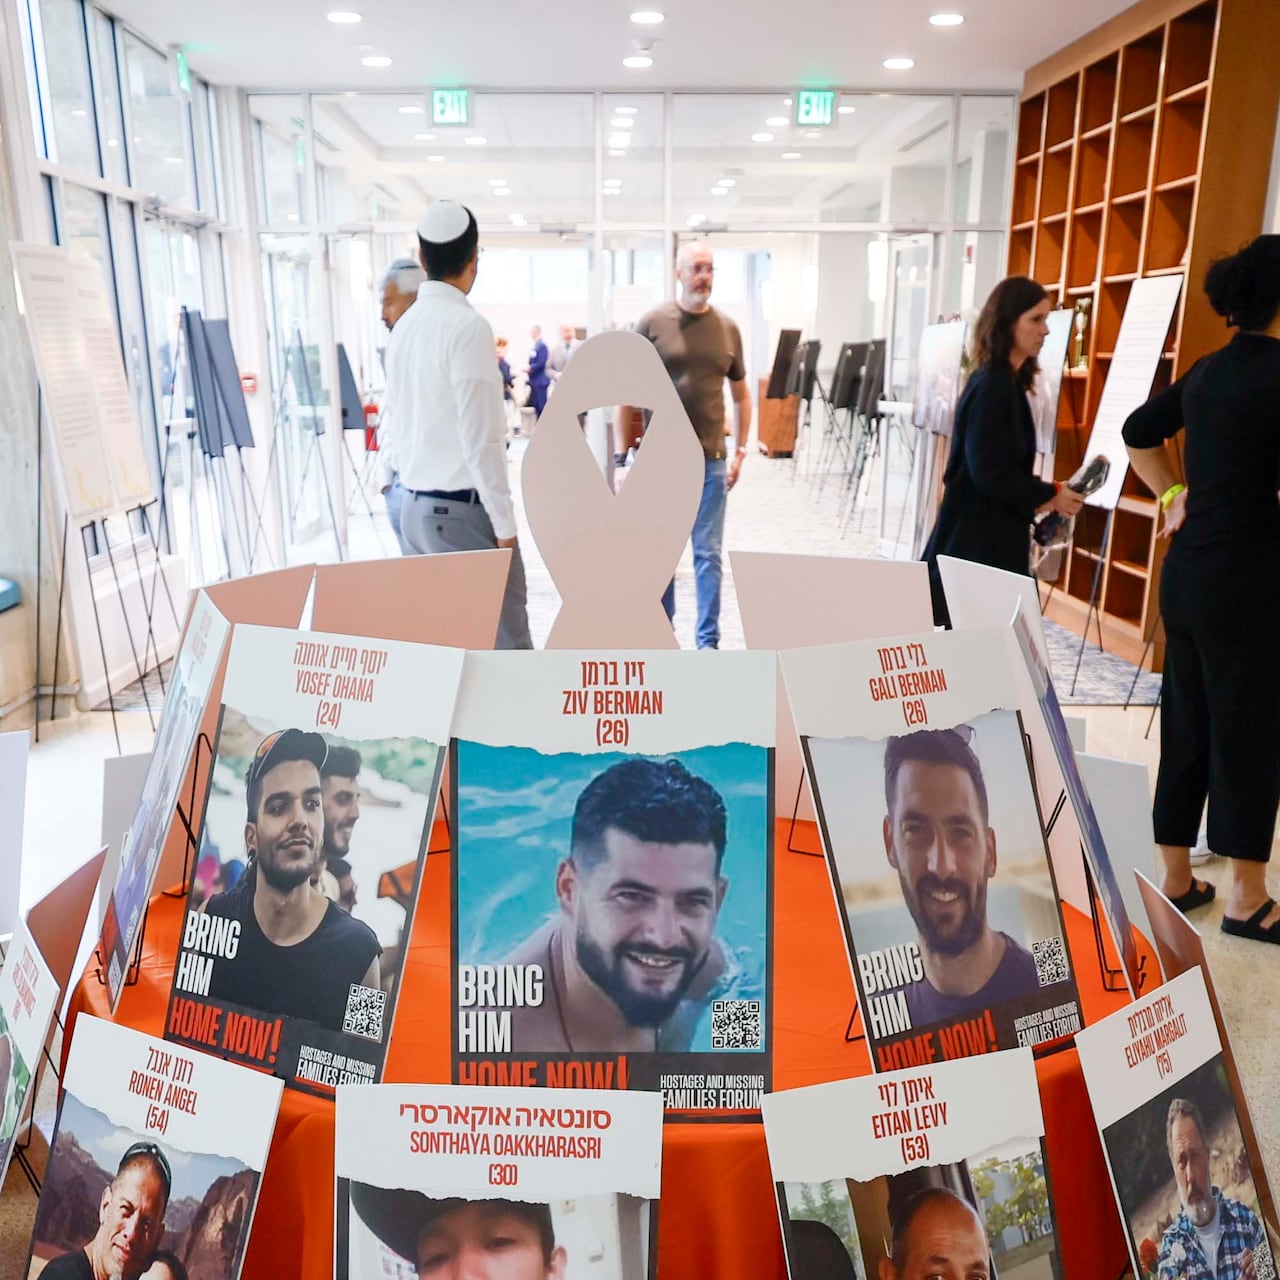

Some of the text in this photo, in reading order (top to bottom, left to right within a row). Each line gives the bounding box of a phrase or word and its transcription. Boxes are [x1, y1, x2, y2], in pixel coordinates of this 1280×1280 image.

[293, 641, 388, 676] יוסף חיים אוחנה
[581, 661, 645, 689] זיו ברמן
[877, 643, 928, 675] גלי ברמן
[296, 669, 375, 703] YOSEF OHANA
[868, 668, 948, 702] GALI BERMAN
[316, 699, 342, 730] (24)
[562, 690, 663, 715] ZIV BERMAN
[902, 698, 928, 728] (26)
[596, 718, 630, 747] (26)
[183, 910, 242, 960] BRING
[175, 951, 214, 997] HIM
[857, 941, 925, 995] BRING
[458, 964, 544, 1008] BRING
[169, 997, 284, 1064] HOME NOW!
[458, 1011, 512, 1053] HIM
[867, 991, 912, 1040] HIM
[1017, 1013, 1082, 1048] FAMILIES FORUM
[877, 1008, 999, 1073] HOME NOW!
[1124, 1013, 1188, 1069] ELIYAHU MARGALIT
[146, 1046, 194, 1085] רונן אנגל
[296, 1058, 338, 1088] FAMILIES
[300, 1044, 376, 1080] HOSTAGES AND MISSING
[128, 1069, 198, 1116] RONEN ANGEL
[660, 1074, 765, 1089] HOSTAGES AND MISSING
[878, 1076, 936, 1108] איתן לוי
[662, 1089, 764, 1110] FAMILIES FORUM
[145, 1103, 170, 1136] (54)
[400, 1103, 612, 1132] סונטאיה אוקארסרי
[872, 1102, 948, 1139] EITAN LEVY
[410, 1131, 602, 1160] SONTHAYA OAKKHARASRI
[901, 1133, 930, 1165] (53)
[488, 1163, 518, 1186] (30)
